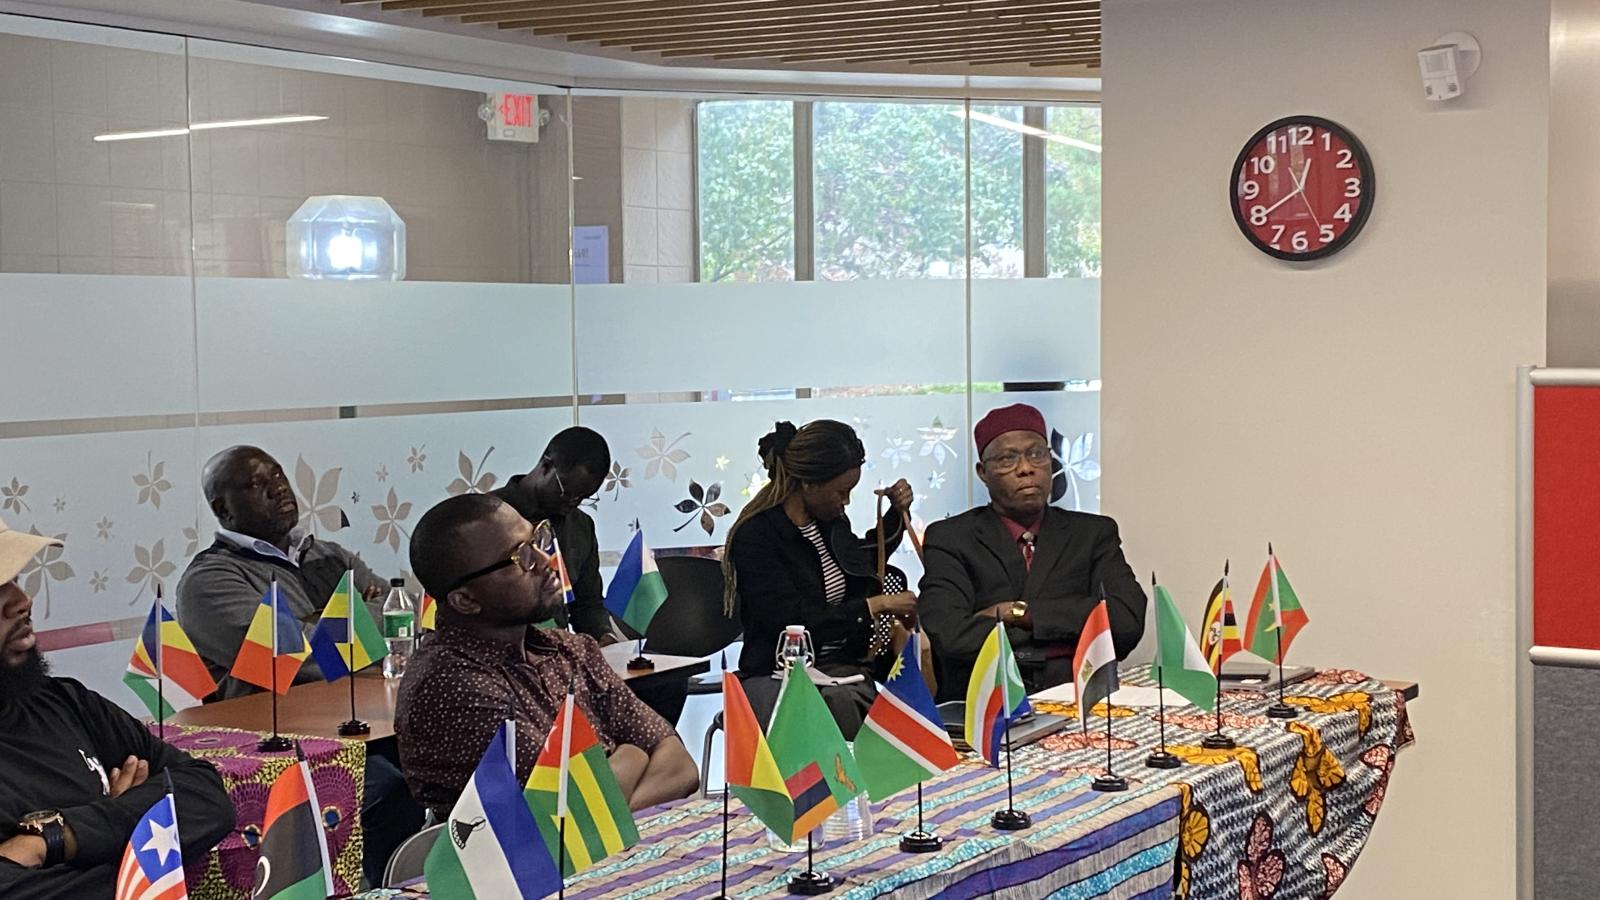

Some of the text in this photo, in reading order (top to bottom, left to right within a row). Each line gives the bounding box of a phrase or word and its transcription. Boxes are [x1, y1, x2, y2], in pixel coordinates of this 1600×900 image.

[505, 94, 532, 128] EXIT
[1268, 135, 1287, 154] 11
[1289, 126, 1313, 145] 12
[1321, 133, 1331, 152] 1
[1251, 155, 1275, 175] 10
[1336, 149, 1353, 168] 2
[1243, 181, 1260, 200] 9
[1344, 177, 1361, 197] 3
[1250, 205, 1267, 226] 8
[1333, 203, 1352, 223] 4
[1271, 225, 1285, 243] 7
[1291, 231, 1308, 250] 6
[1319, 224, 1335, 243] 5
